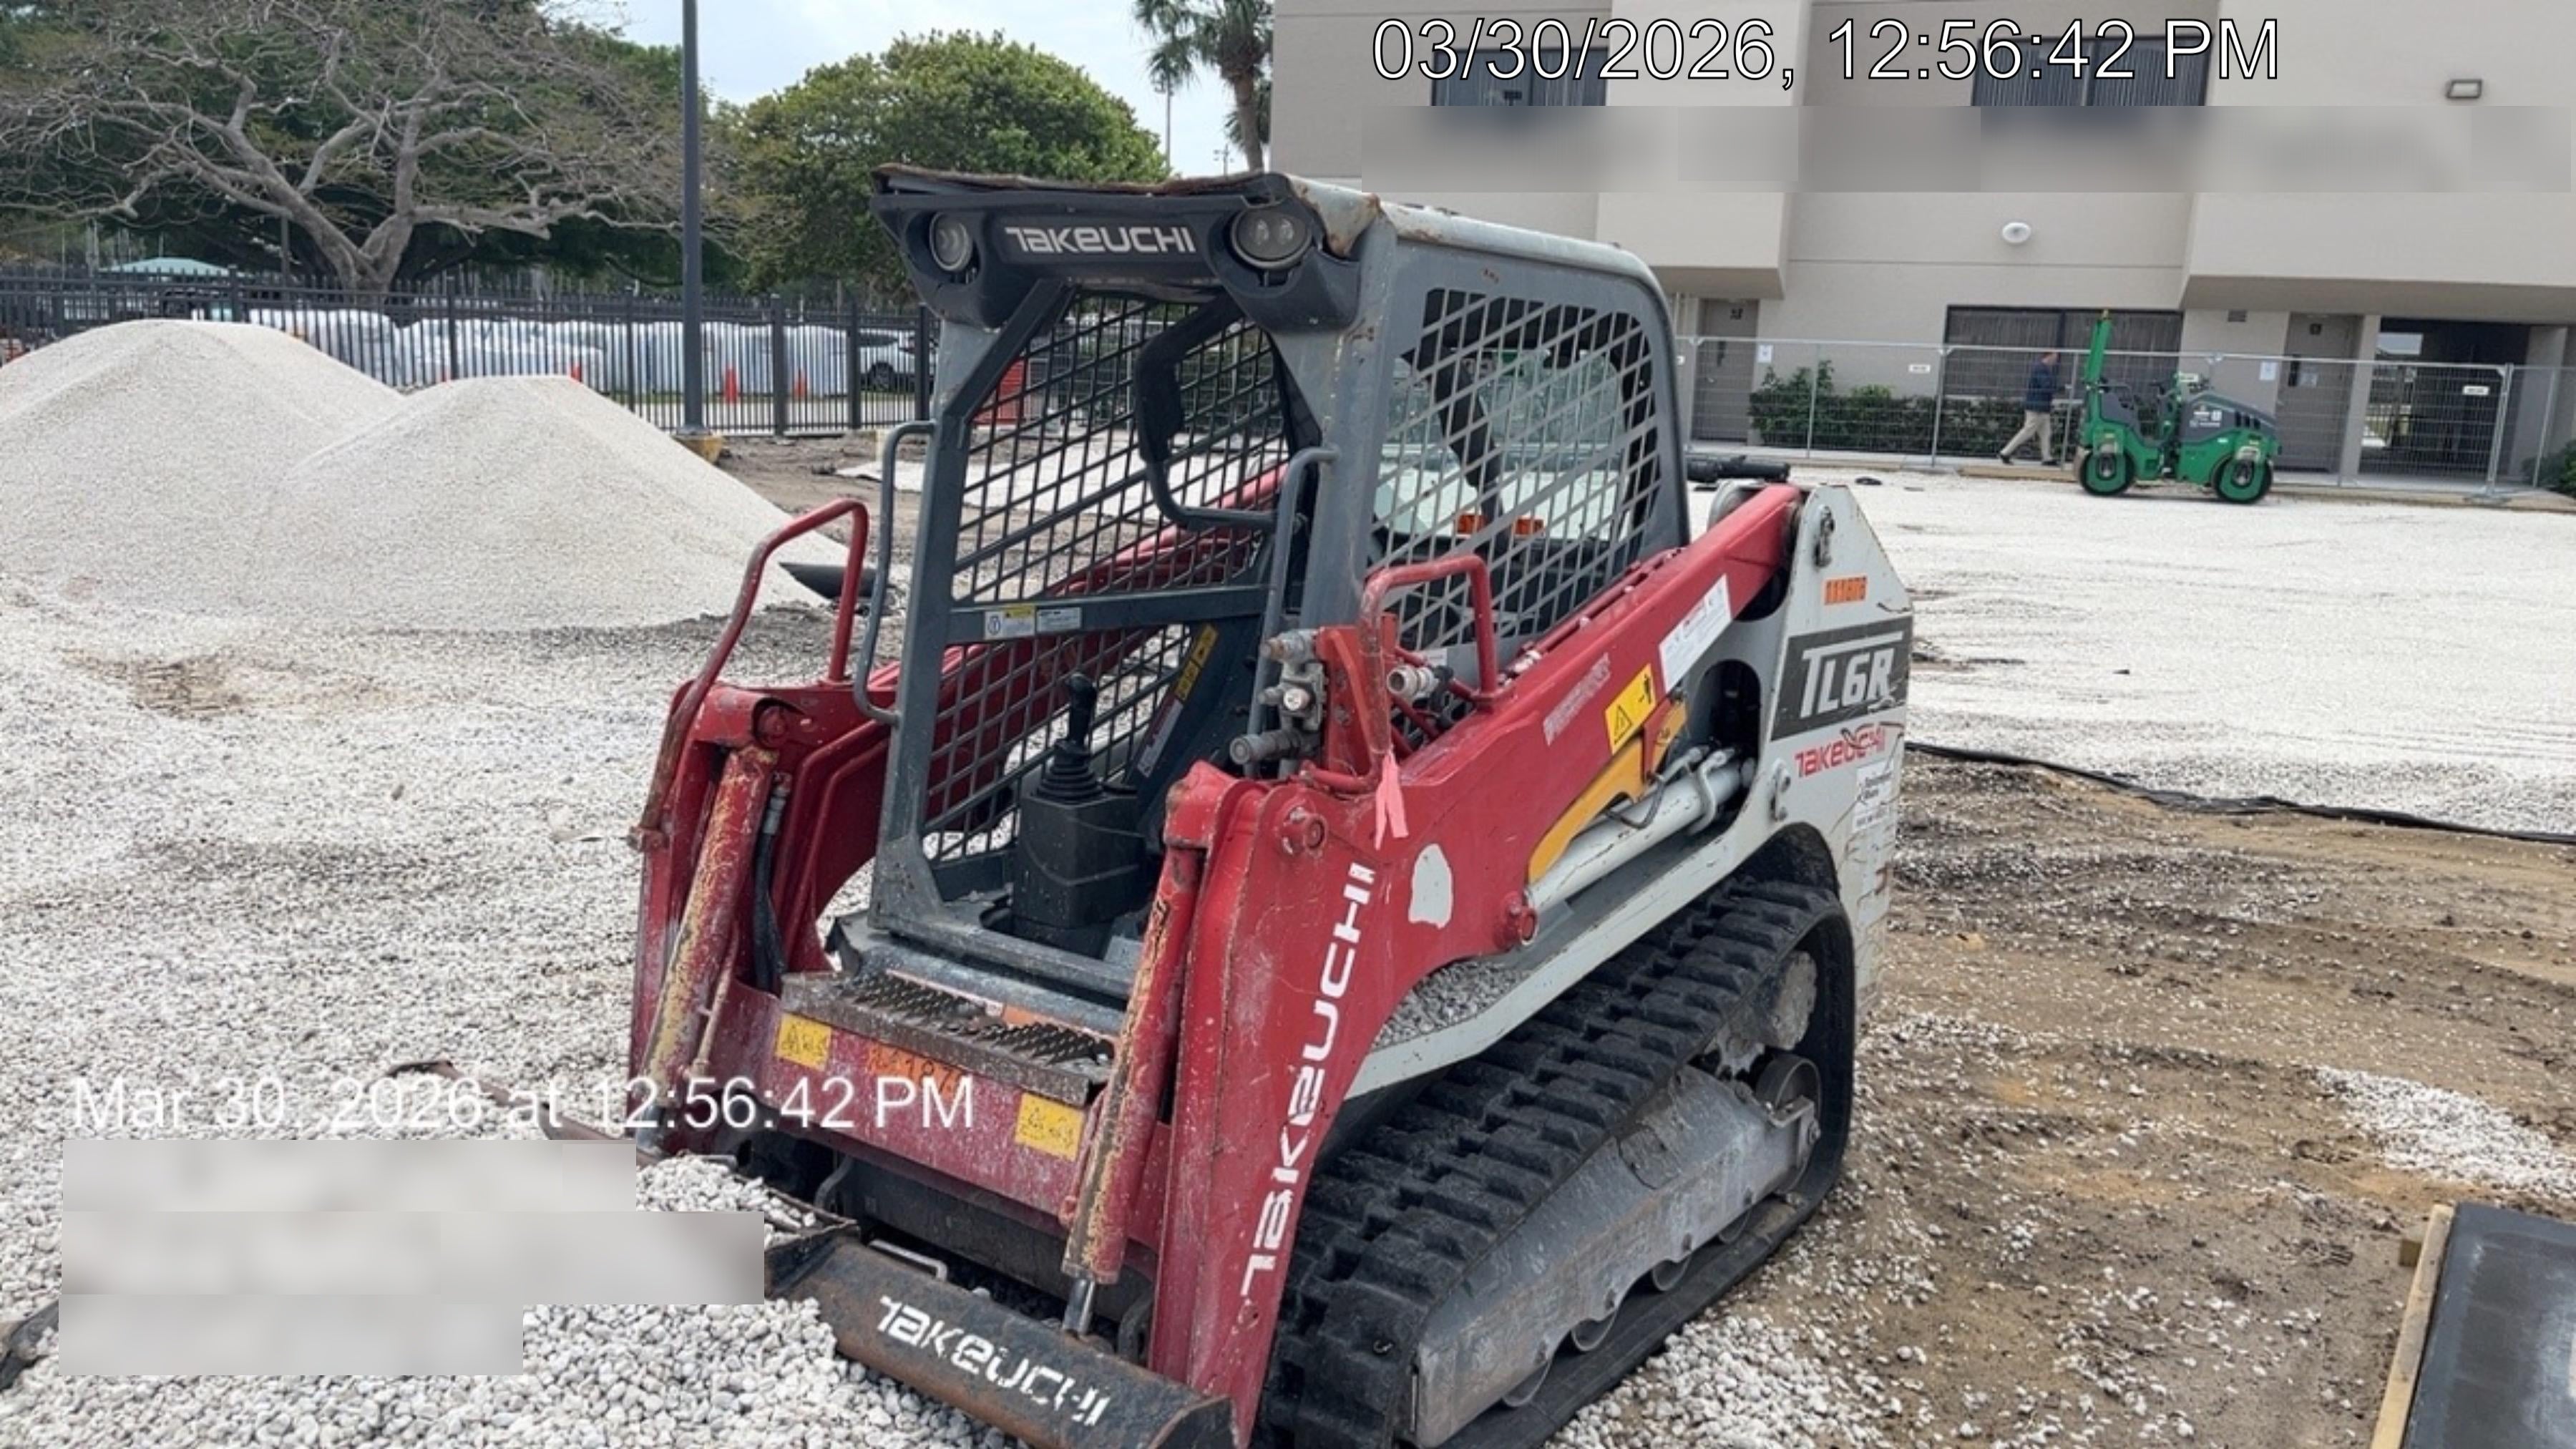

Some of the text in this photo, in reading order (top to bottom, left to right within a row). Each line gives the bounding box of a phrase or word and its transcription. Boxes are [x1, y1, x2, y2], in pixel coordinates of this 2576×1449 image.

[1005, 226, 1196, 253] TAKEUCHI
[1800, 631, 1903, 718] TL6R
[1240, 862, 1375, 1297] TAKEUCHI
[877, 1295, 1111, 1428] TAKEUCHI
